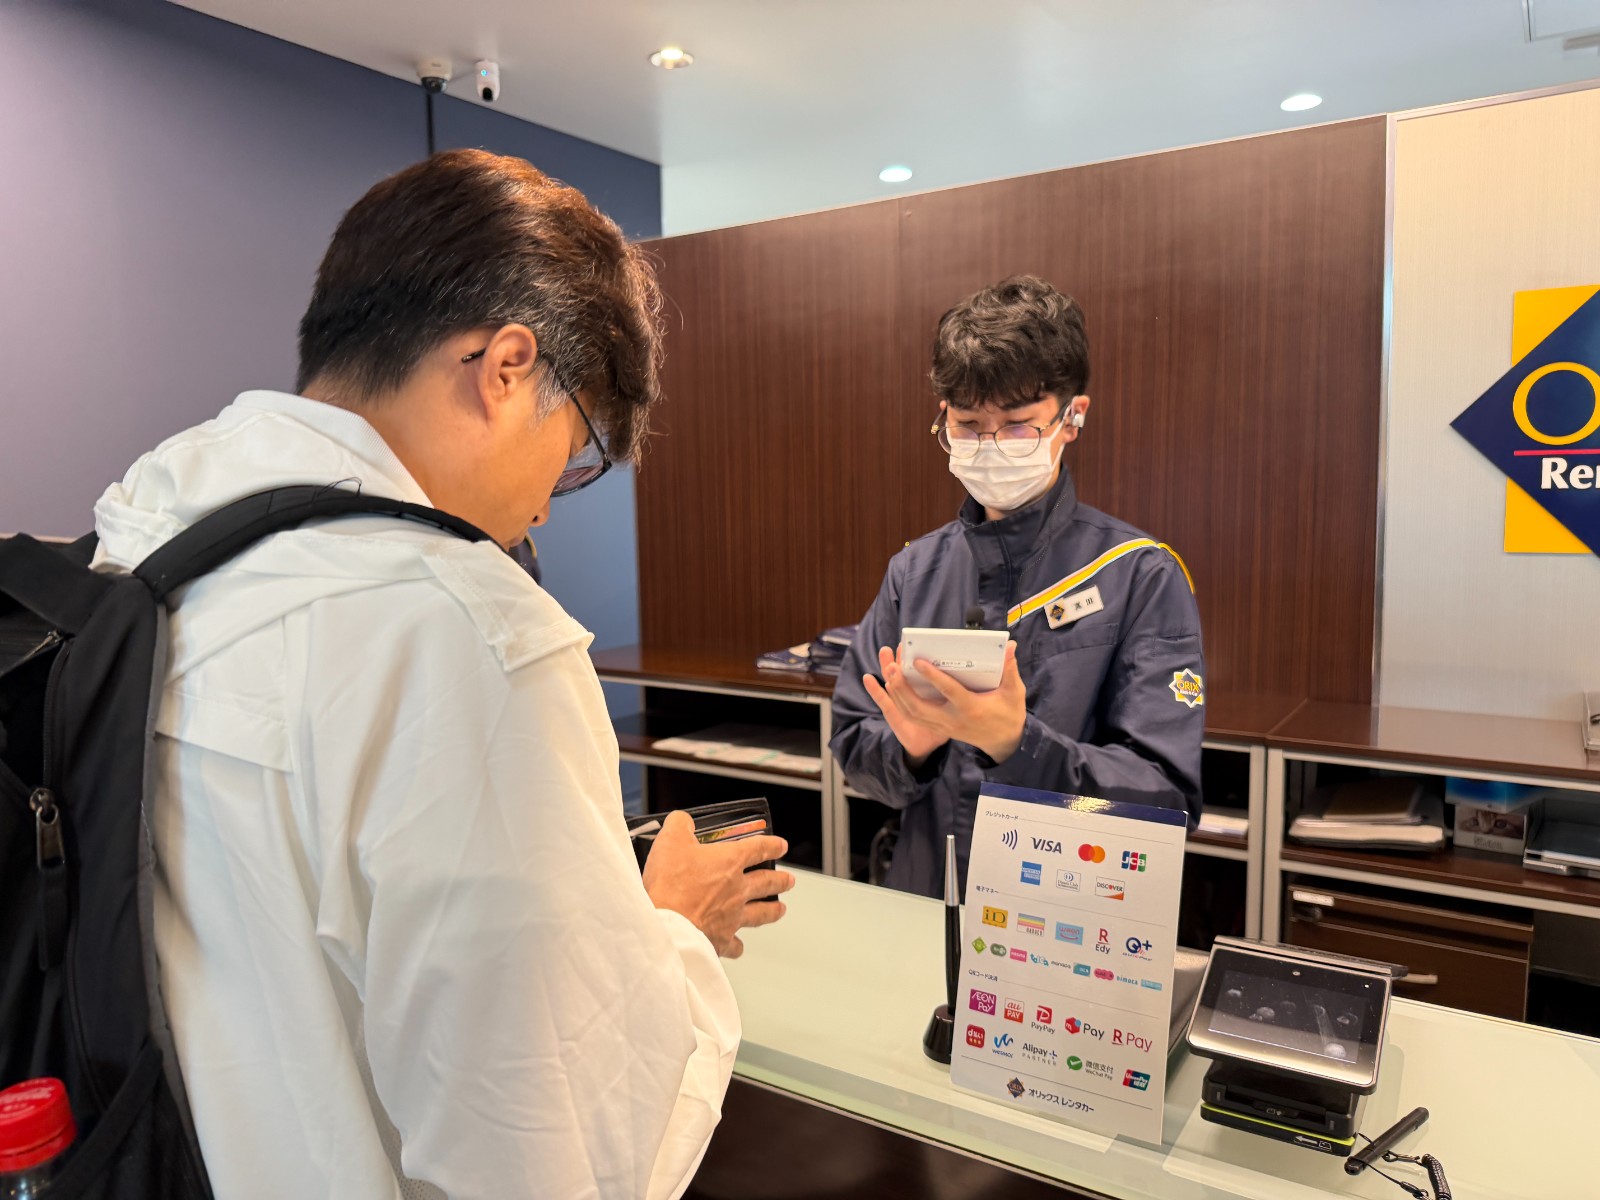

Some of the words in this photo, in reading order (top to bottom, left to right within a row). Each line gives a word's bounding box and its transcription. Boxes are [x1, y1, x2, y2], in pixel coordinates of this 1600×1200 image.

[1541, 457, 1600, 490] Re
[1177, 679, 1200, 693] ORIX
[985, 811, 1019, 820] クレジットカード
[1030, 836, 1062, 854] VISA
[976, 885, 999, 894] 電子マネー
[1096, 881, 1124, 892] DISCOVER
[985, 908, 1006, 924] iD
[1099, 927, 1109, 943] R
[1095, 943, 1110, 955] Edy
[1007, 1002, 1022, 1011] au
[1006, 1009, 1021, 1020] PAY
[1031, 1021, 1056, 1035] PayPay
[1083, 1022, 1105, 1041] Pay
[1112, 1028, 1123, 1045] R
[1126, 1032, 1153, 1053] Pay
[1021, 1052, 1057, 1067] PARTNER
[1085, 1060, 1114, 1075] 微信支付
[1085, 1067, 1104, 1078] WeChat
[1104, 1072, 1113, 1081] Pay
